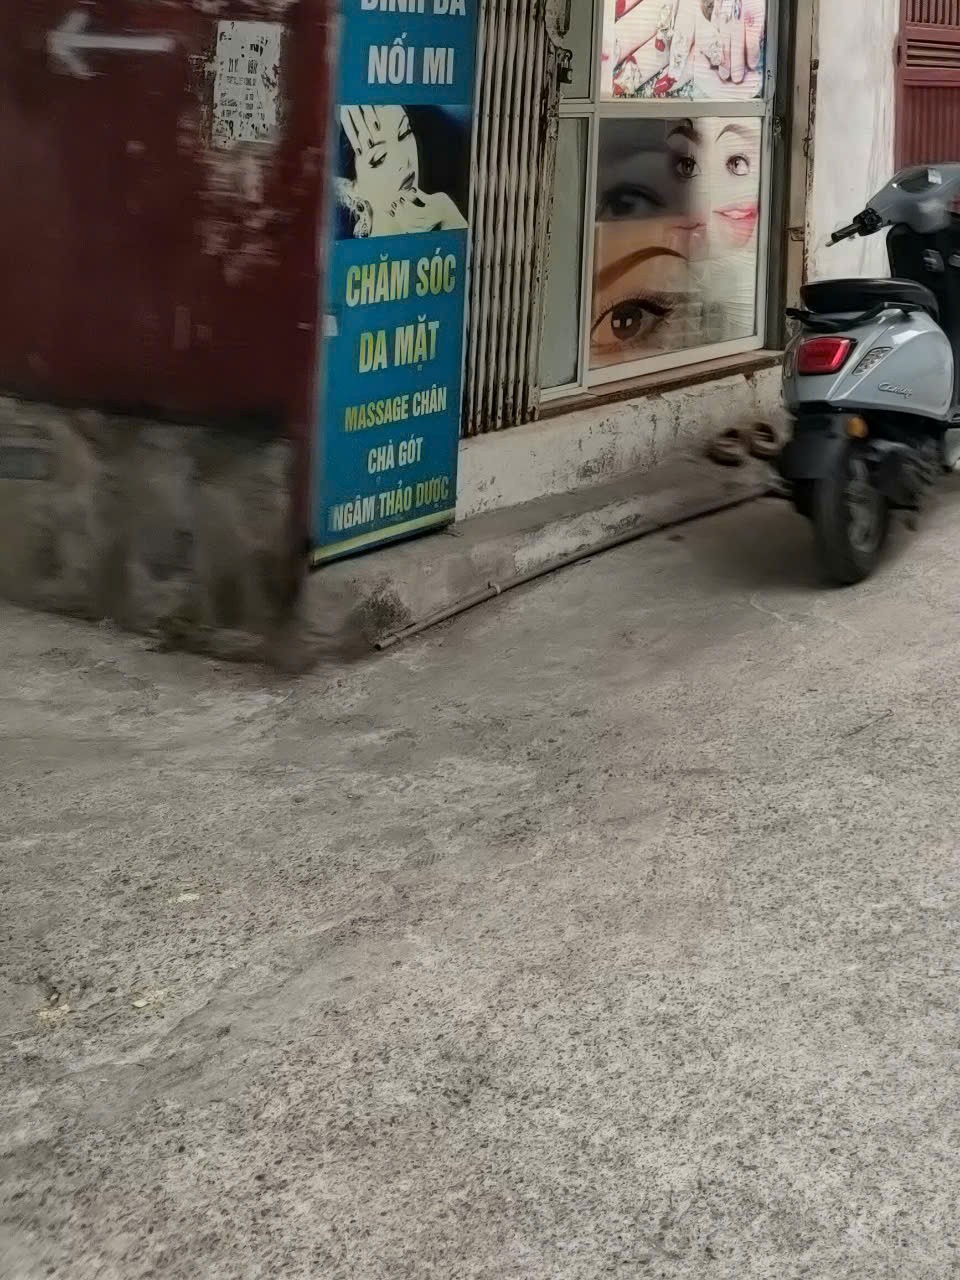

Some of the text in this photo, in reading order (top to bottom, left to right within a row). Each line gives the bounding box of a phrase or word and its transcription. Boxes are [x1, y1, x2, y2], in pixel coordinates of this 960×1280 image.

[367, 32, 455, 85] NỐI MI
[345, 247, 457, 308] CHĂM SÓC
[358, 314, 440, 374] DA MẶT
[344, 384, 447, 433] MASSAGE CHÂN
[367, 434, 424, 475] CHÀ GÓT
[332, 494, 376, 532] NGÂM
[378, 480, 413, 520] THẢO
